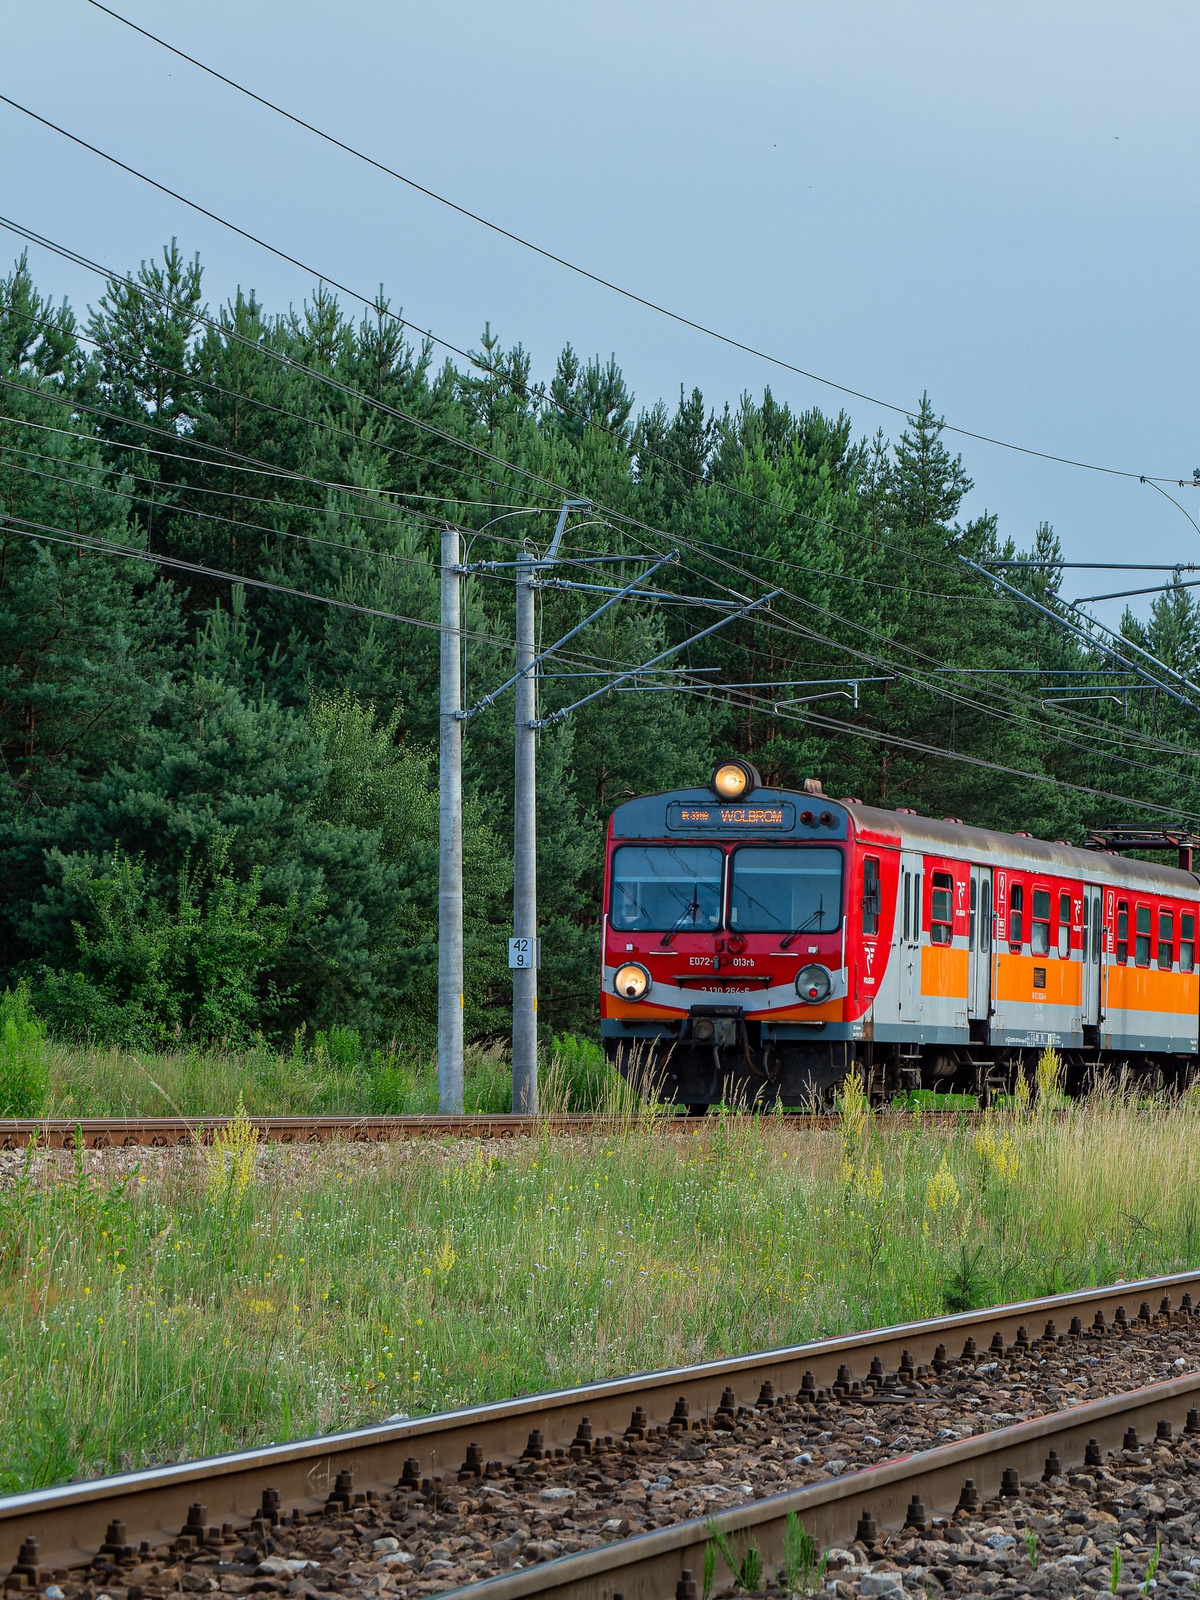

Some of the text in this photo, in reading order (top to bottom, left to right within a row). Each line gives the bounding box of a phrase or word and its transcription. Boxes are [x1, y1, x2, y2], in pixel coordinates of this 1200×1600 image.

[721, 810, 782, 823] WOLBROM
[514, 940, 528, 952] 42
[517, 954, 524, 966] 9
